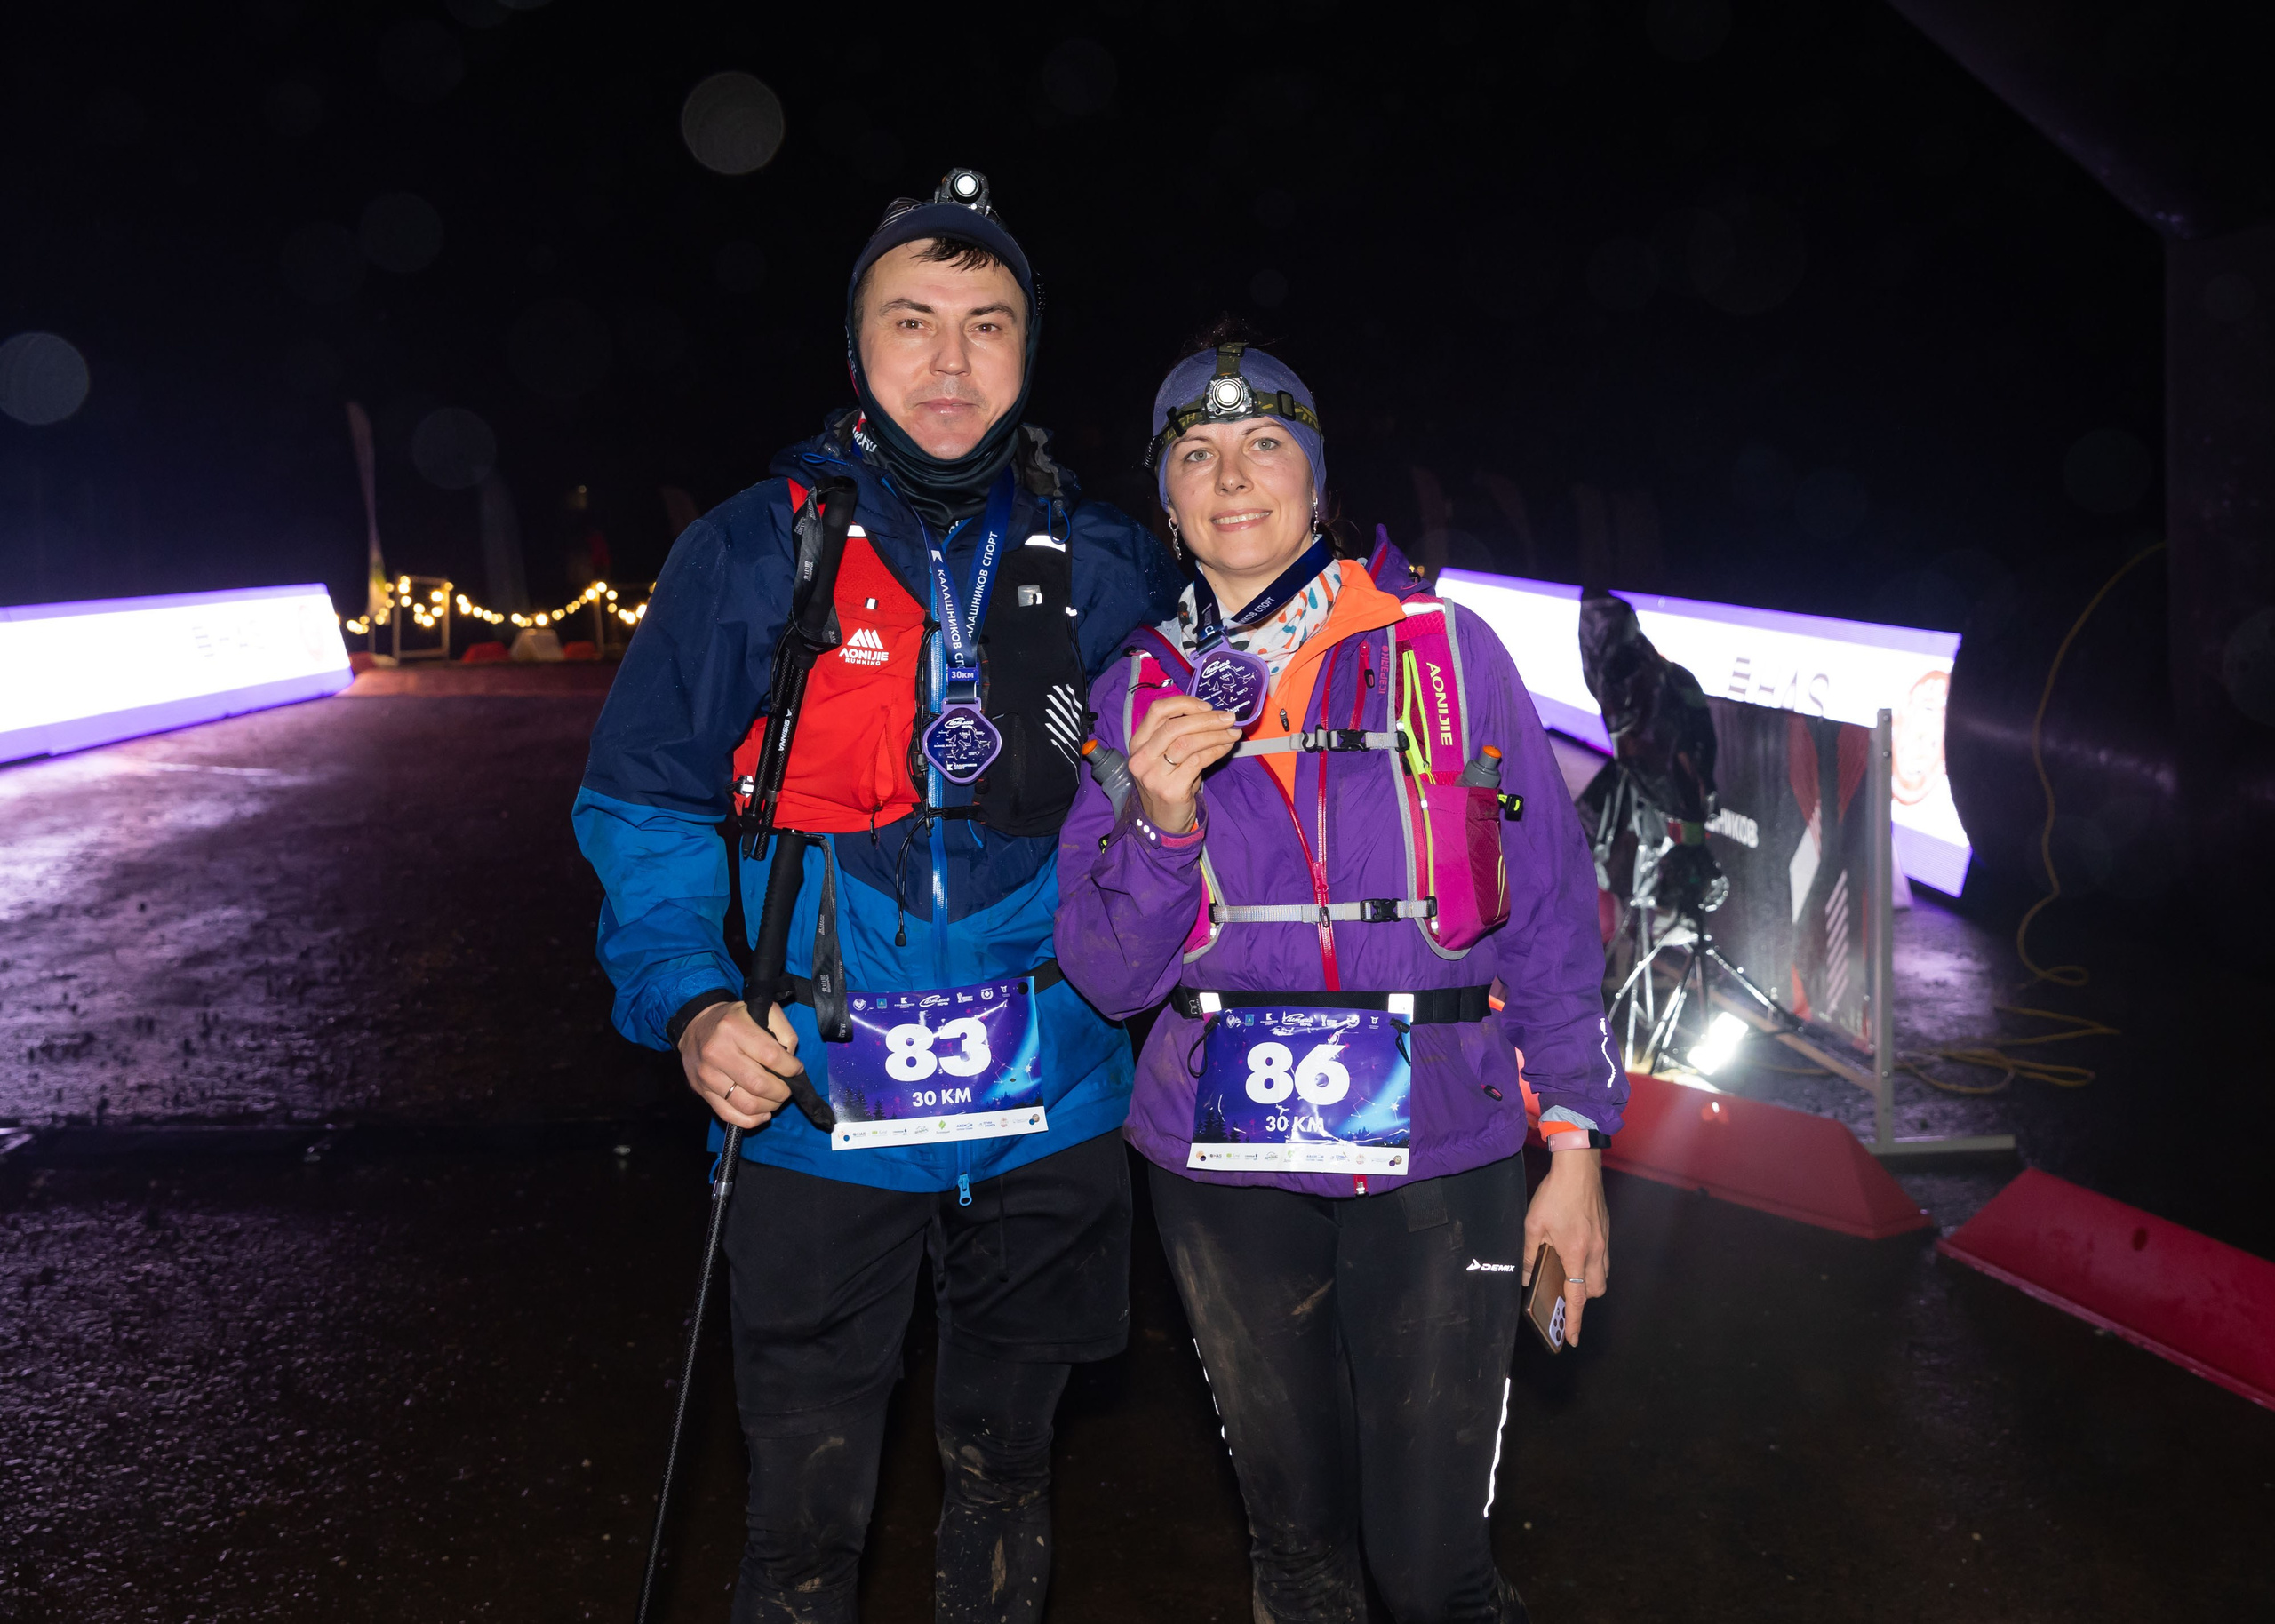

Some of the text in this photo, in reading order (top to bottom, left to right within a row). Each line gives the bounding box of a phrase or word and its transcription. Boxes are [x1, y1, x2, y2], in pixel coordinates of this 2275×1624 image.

[965, 531, 998, 641] АЛАШНИКОВ СПОРТ
[938, 569, 962, 649] КАЛАШНИКОВ
[1254, 596, 1276, 613] СПОРТ
[839, 648, 890, 661] AONIJIE
[845, 657, 881, 666] RUNNING
[1426, 662, 1453, 745] AONIJIE
[778, 719, 791, 752] BISINNA
[884, 1017, 992, 1082] 83
[1245, 1041, 1351, 1105] 86
[912, 1087, 972, 1107] 30 КМ
[1265, 1115, 1324, 1133] 30 КМ
[1480, 1263, 1516, 1272] DEMIX
